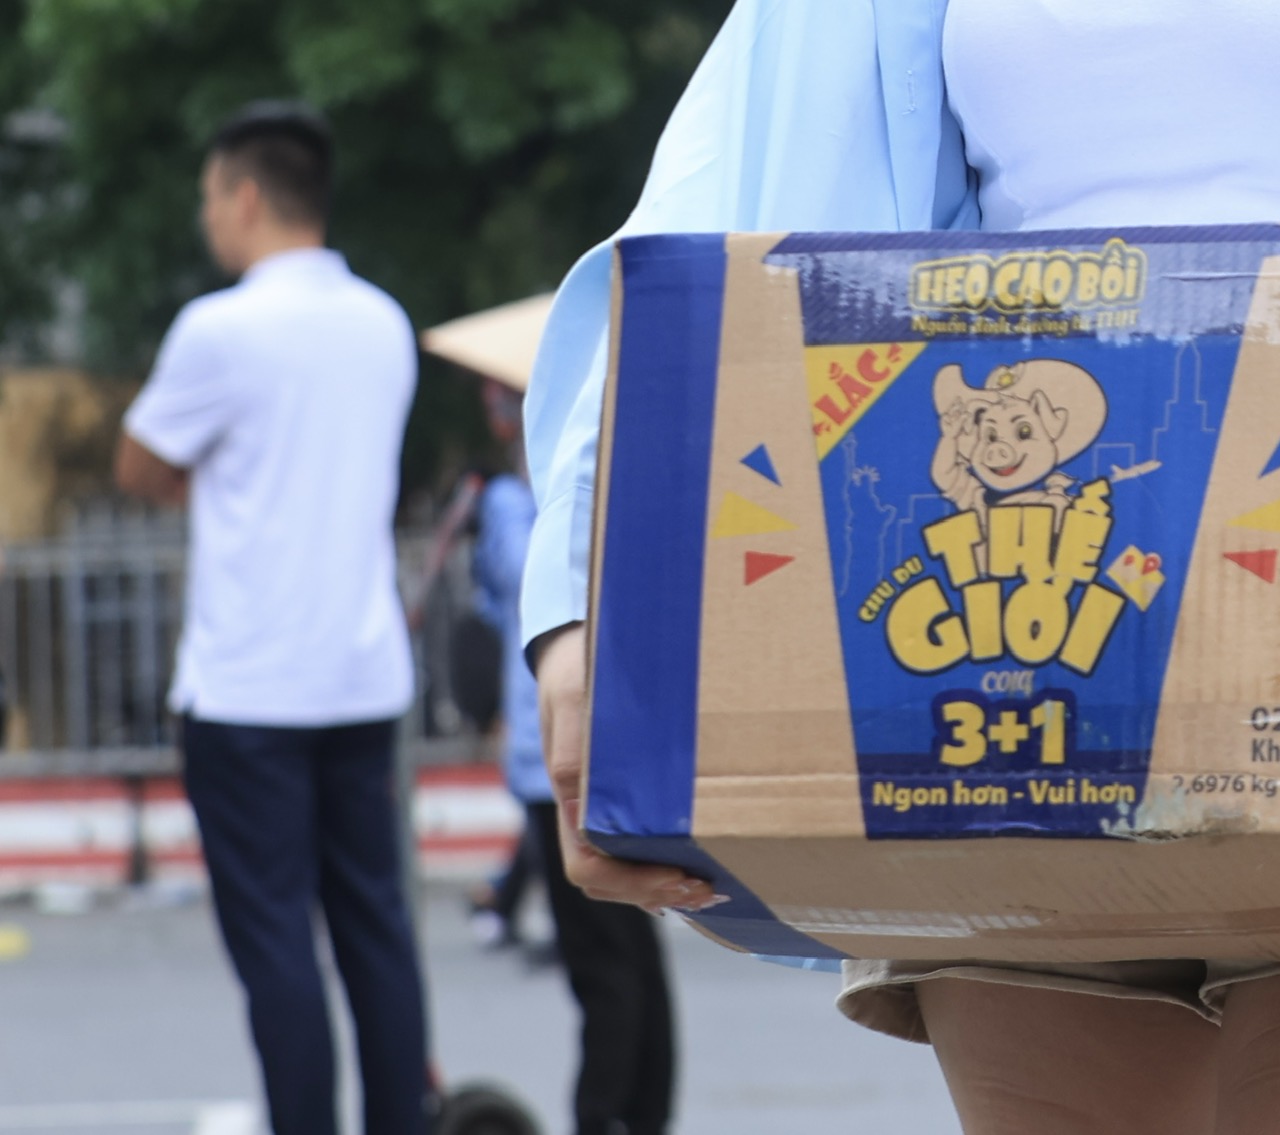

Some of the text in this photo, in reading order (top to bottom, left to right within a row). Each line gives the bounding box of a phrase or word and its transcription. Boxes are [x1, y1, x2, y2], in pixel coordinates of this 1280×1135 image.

[917, 263, 990, 306] HEO
[994, 260, 1073, 308] CAO
[922, 478, 1113, 588] THẾ
[858, 556, 923, 622] CHU DU
[940, 700, 1066, 767] 3+1
[873, 781, 948, 812] Ngon
[953, 778, 1008, 805] hơn
[1028, 778, 1076, 805] Vui
[1081, 777, 1135, 804] hơn
[1251, 773, 1278, 798] kg
